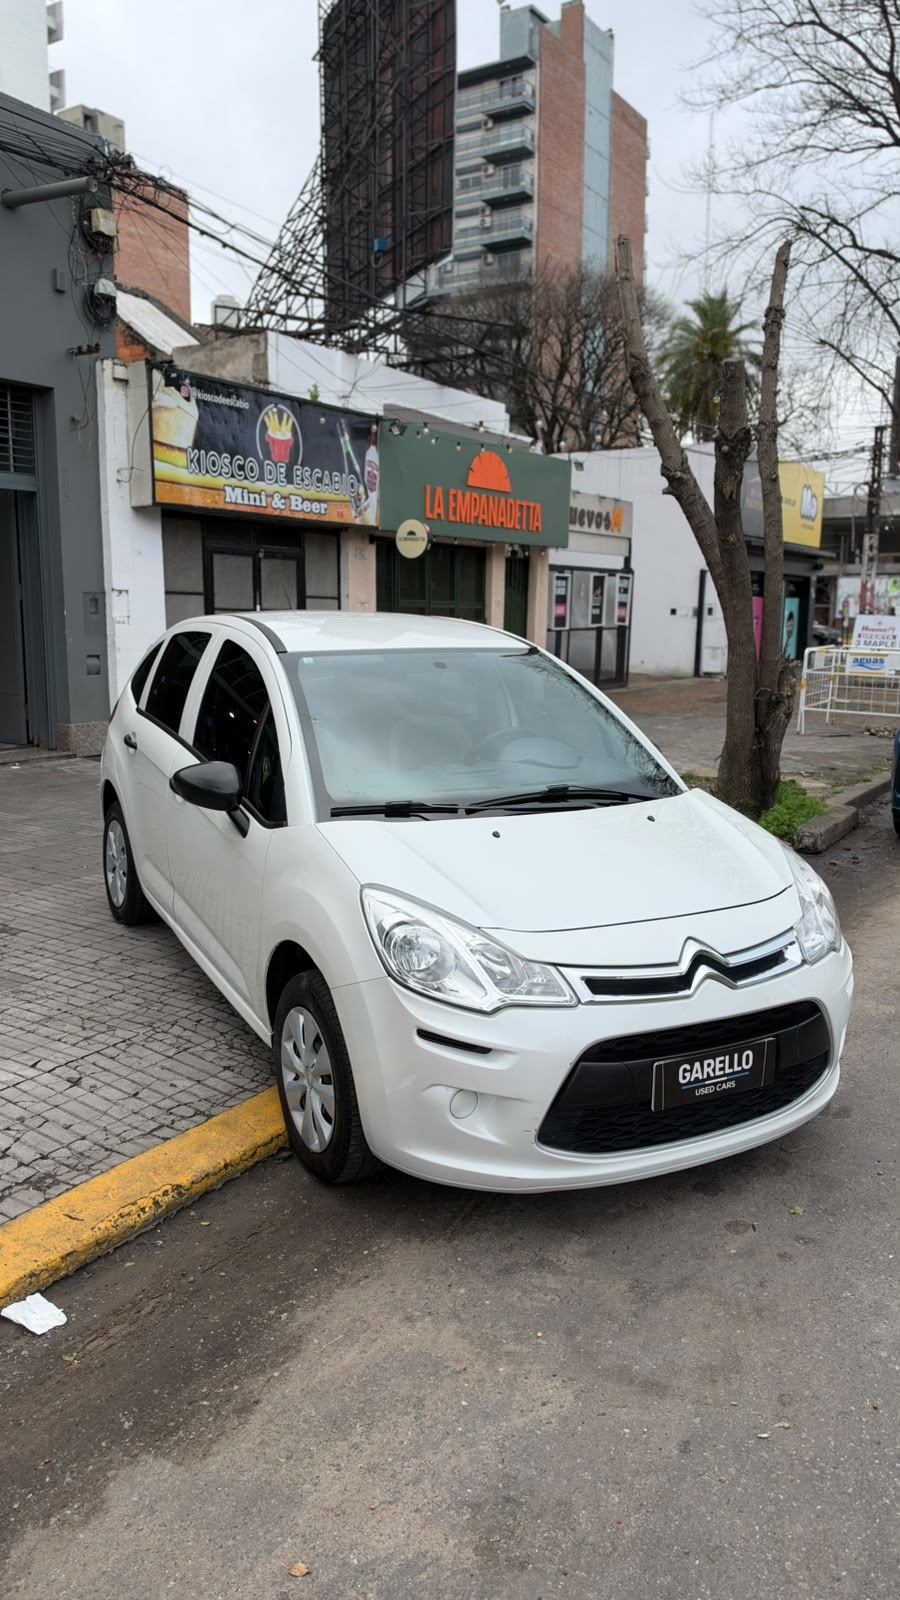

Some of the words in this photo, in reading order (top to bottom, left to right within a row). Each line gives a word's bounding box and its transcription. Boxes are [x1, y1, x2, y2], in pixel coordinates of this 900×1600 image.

[190, 386, 250, 410] @kioscodeescabio
[186, 448, 259, 482] KIOSCO
[264, 460, 287, 486] DE
[293, 464, 359, 497] ESCABIO
[224, 485, 267, 508] Mini
[272, 492, 288, 510] &
[291, 496, 329, 515] Beer
[425, 484, 445, 520] LA
[448, 488, 543, 533] EMPANADETTA
[852, 657, 885, 667] aguas
[678, 1050, 754, 1084] GARELLO
[695, 1085, 715, 1096] USED
[716, 1080, 736, 1092] CARS
